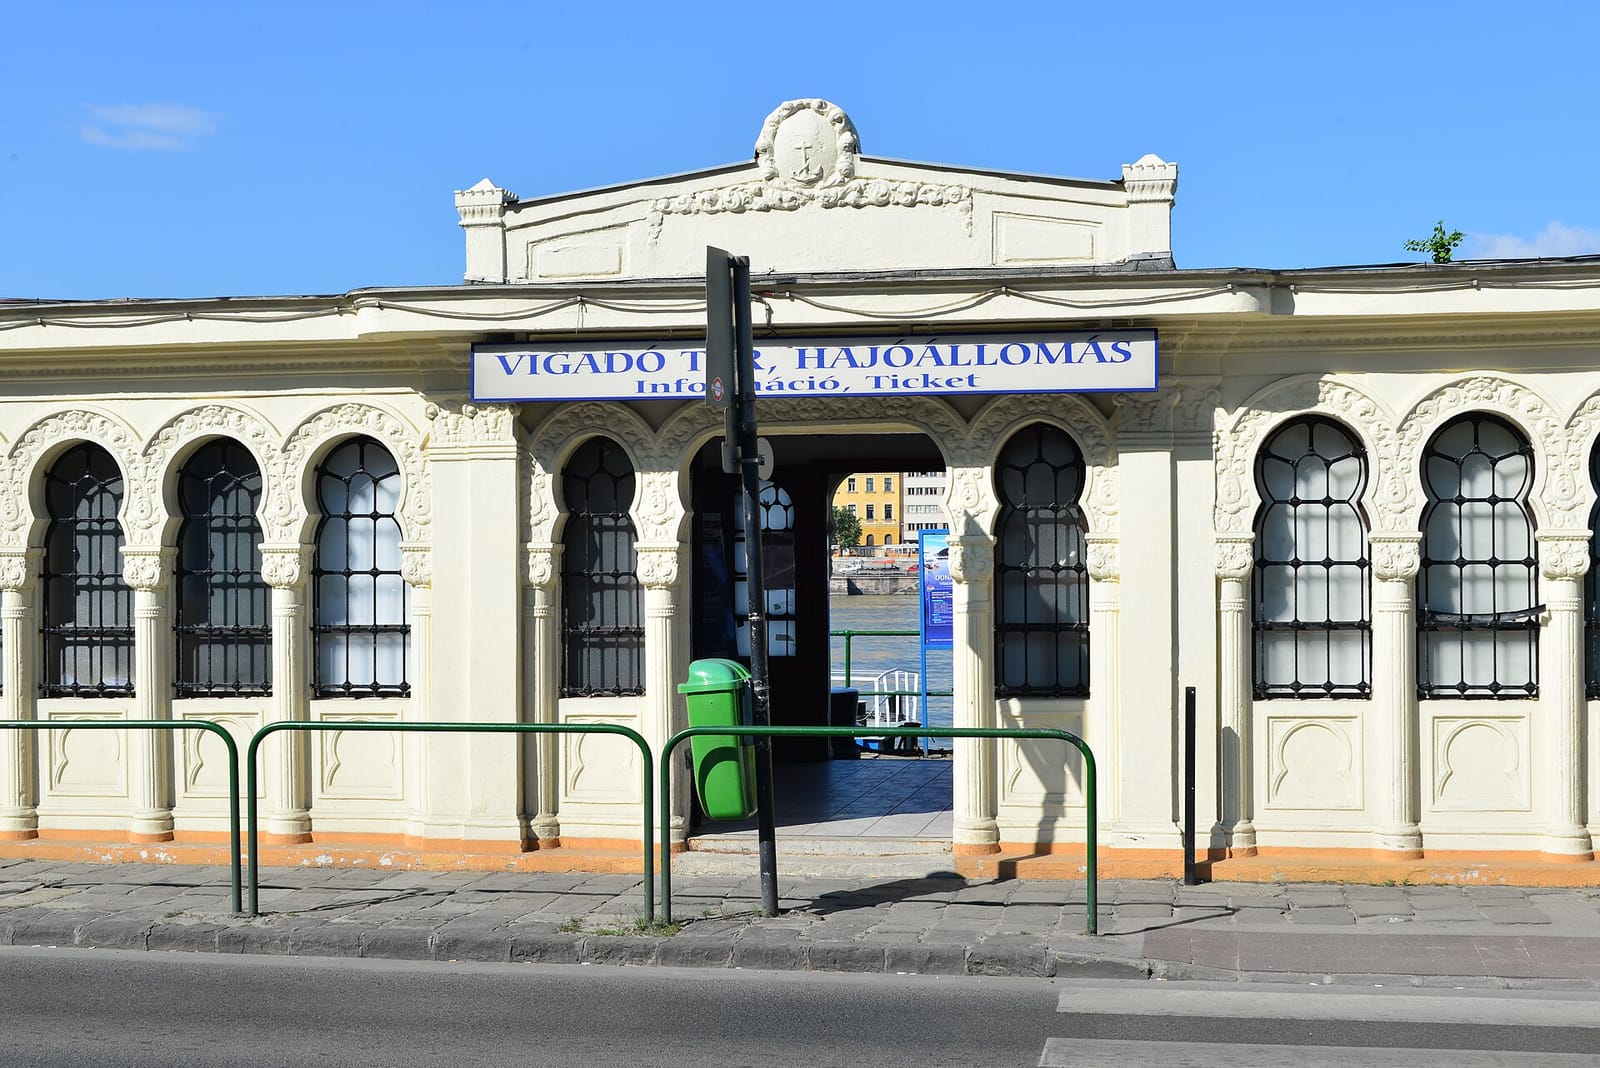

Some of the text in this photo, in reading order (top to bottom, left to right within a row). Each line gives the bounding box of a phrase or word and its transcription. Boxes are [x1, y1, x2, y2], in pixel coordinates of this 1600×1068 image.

[495, 335, 1132, 375] VIGADÓ TR, HAJÓÁLLOMÁS
[636, 373, 981, 394] Infoáció, Ticket
